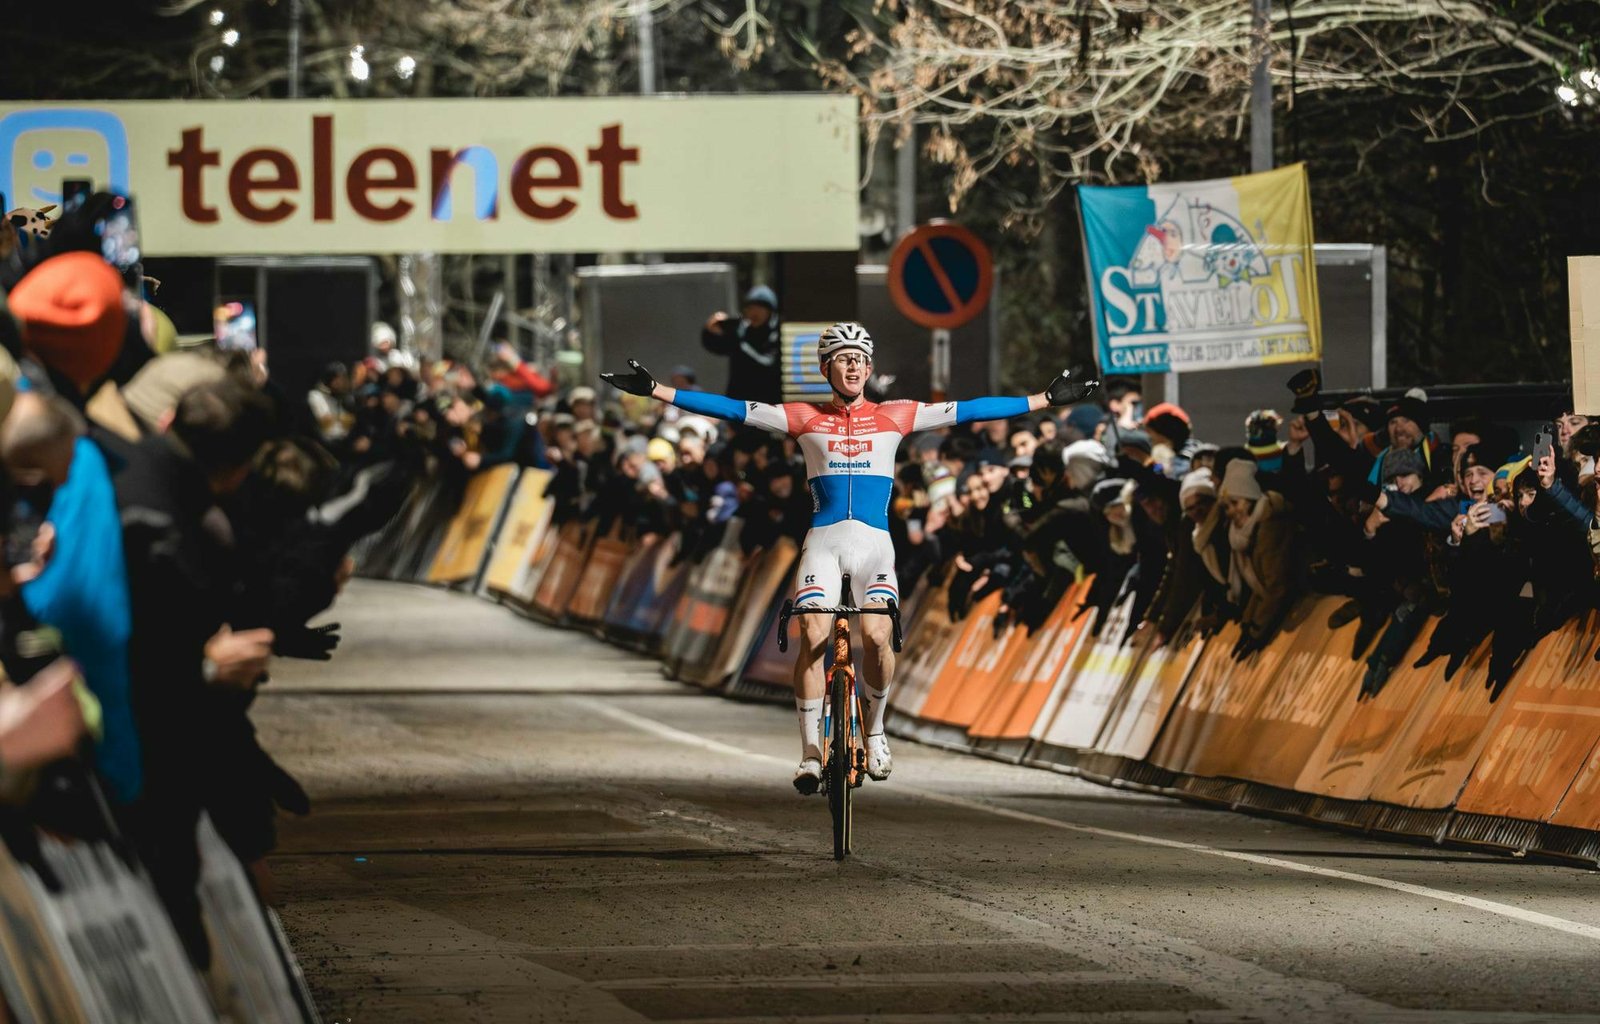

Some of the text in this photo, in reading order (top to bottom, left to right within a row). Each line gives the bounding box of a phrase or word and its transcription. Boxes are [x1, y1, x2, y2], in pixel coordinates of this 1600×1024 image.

[168, 115, 640, 222] telenet
[833, 442, 868, 452] Alpecin
[1477, 724, 1568, 786] STOCK
